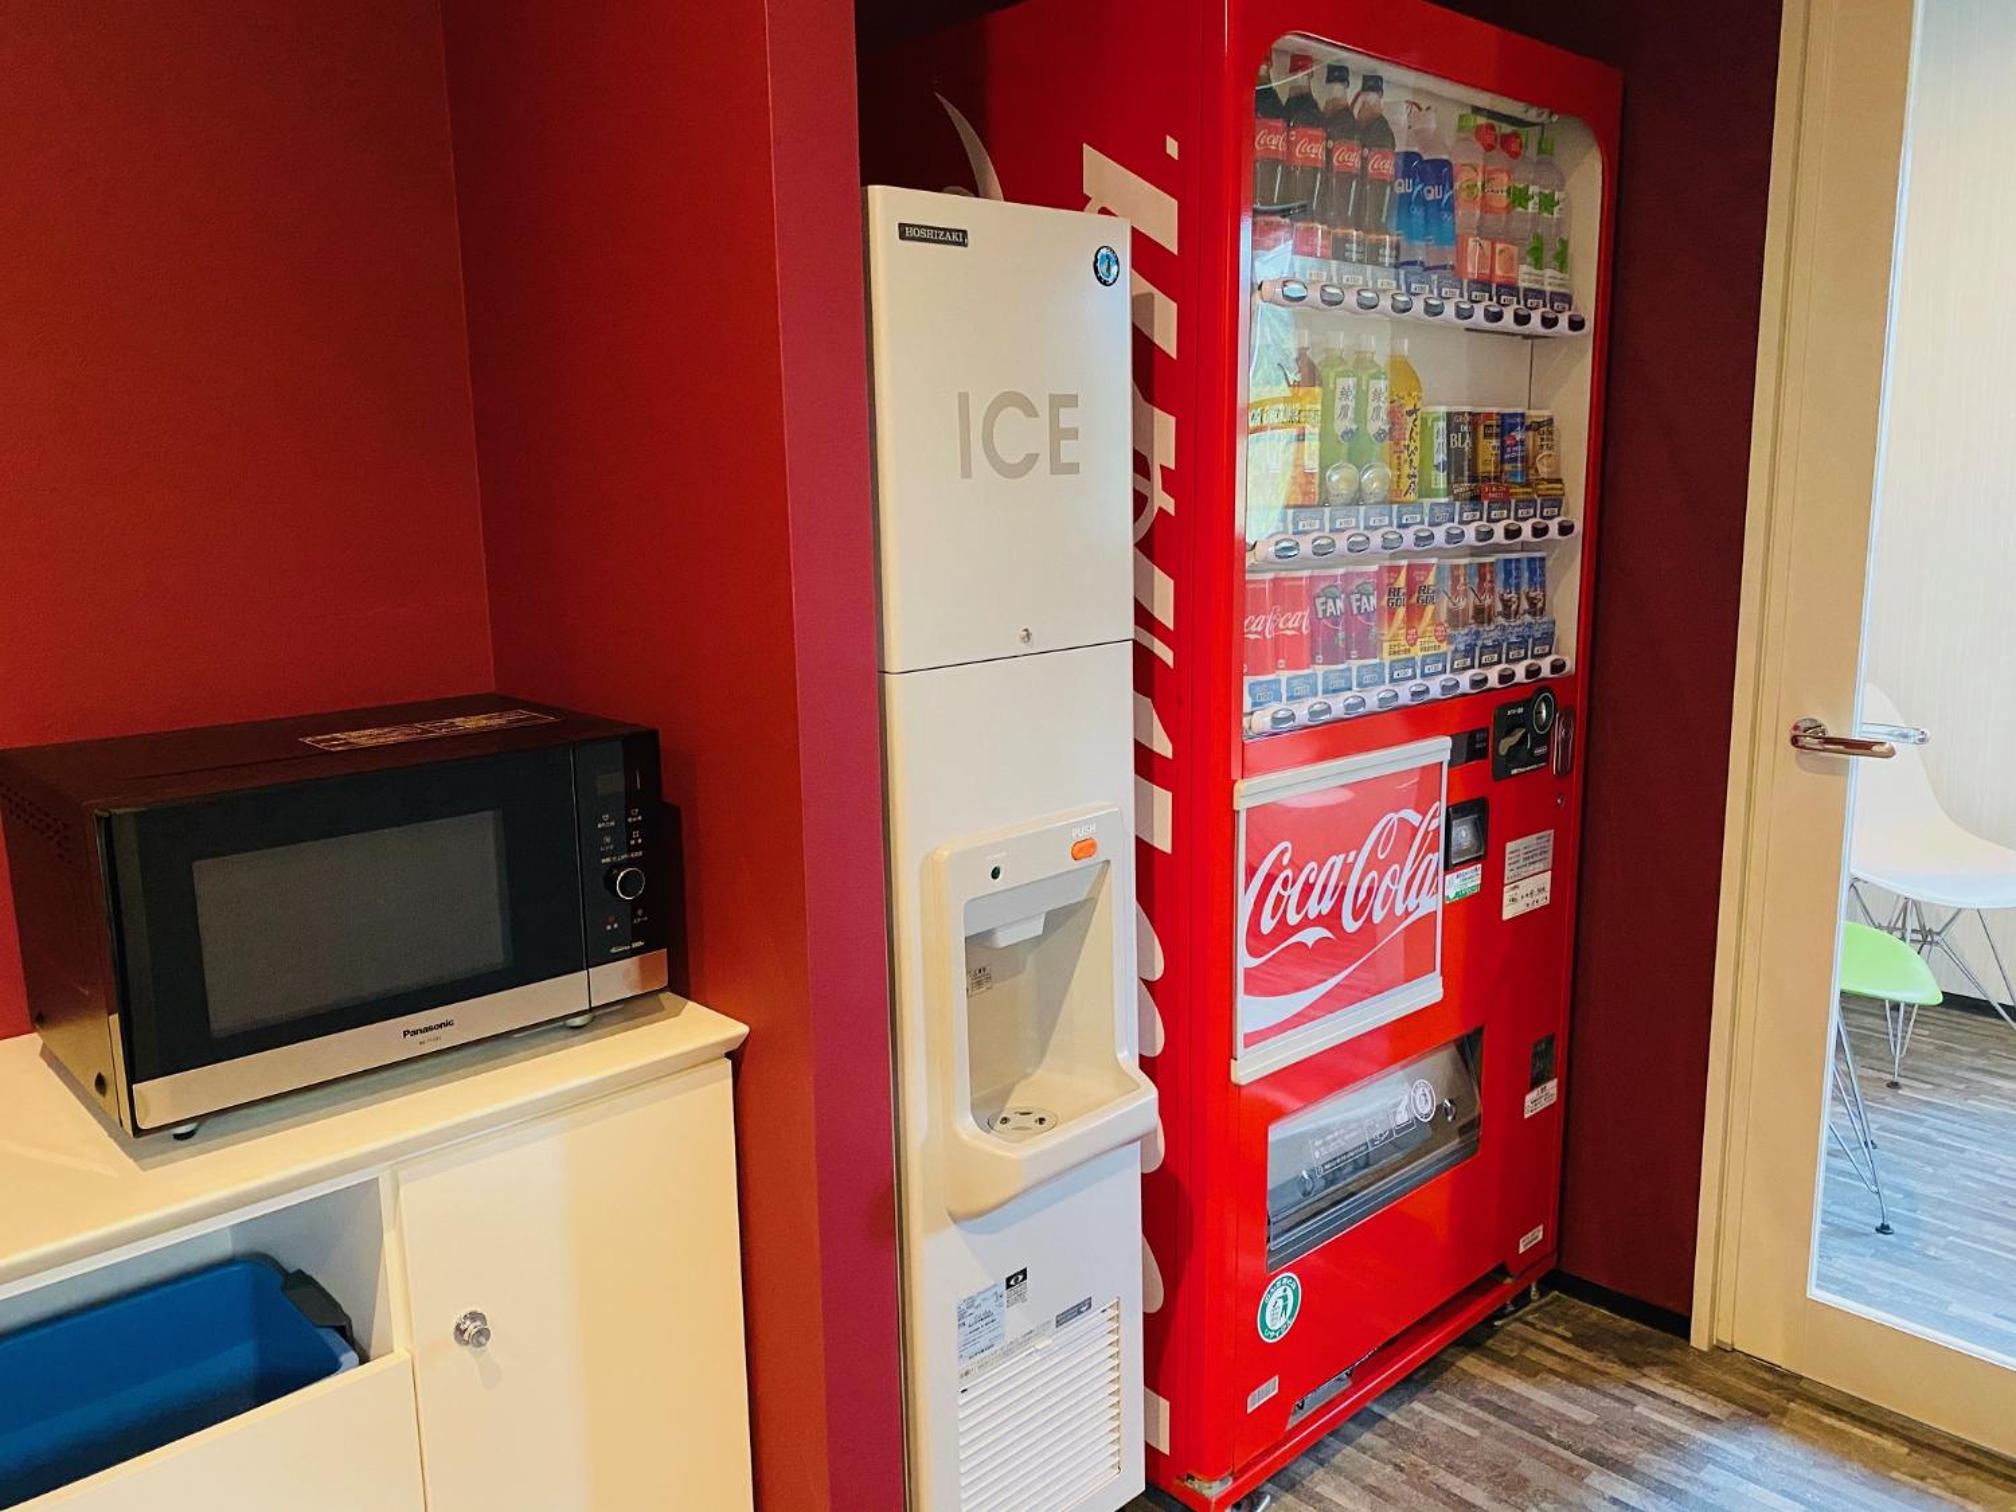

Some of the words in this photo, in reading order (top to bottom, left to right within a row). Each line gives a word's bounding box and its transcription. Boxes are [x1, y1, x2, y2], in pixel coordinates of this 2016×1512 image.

[904, 226, 964, 244] HOSHIZAKI
[957, 390, 1080, 481] ICE
[1071, 823, 1097, 838] PUSH
[1244, 800, 1440, 967] Coca-Cola
[402, 1019, 455, 1039] Panasonic
